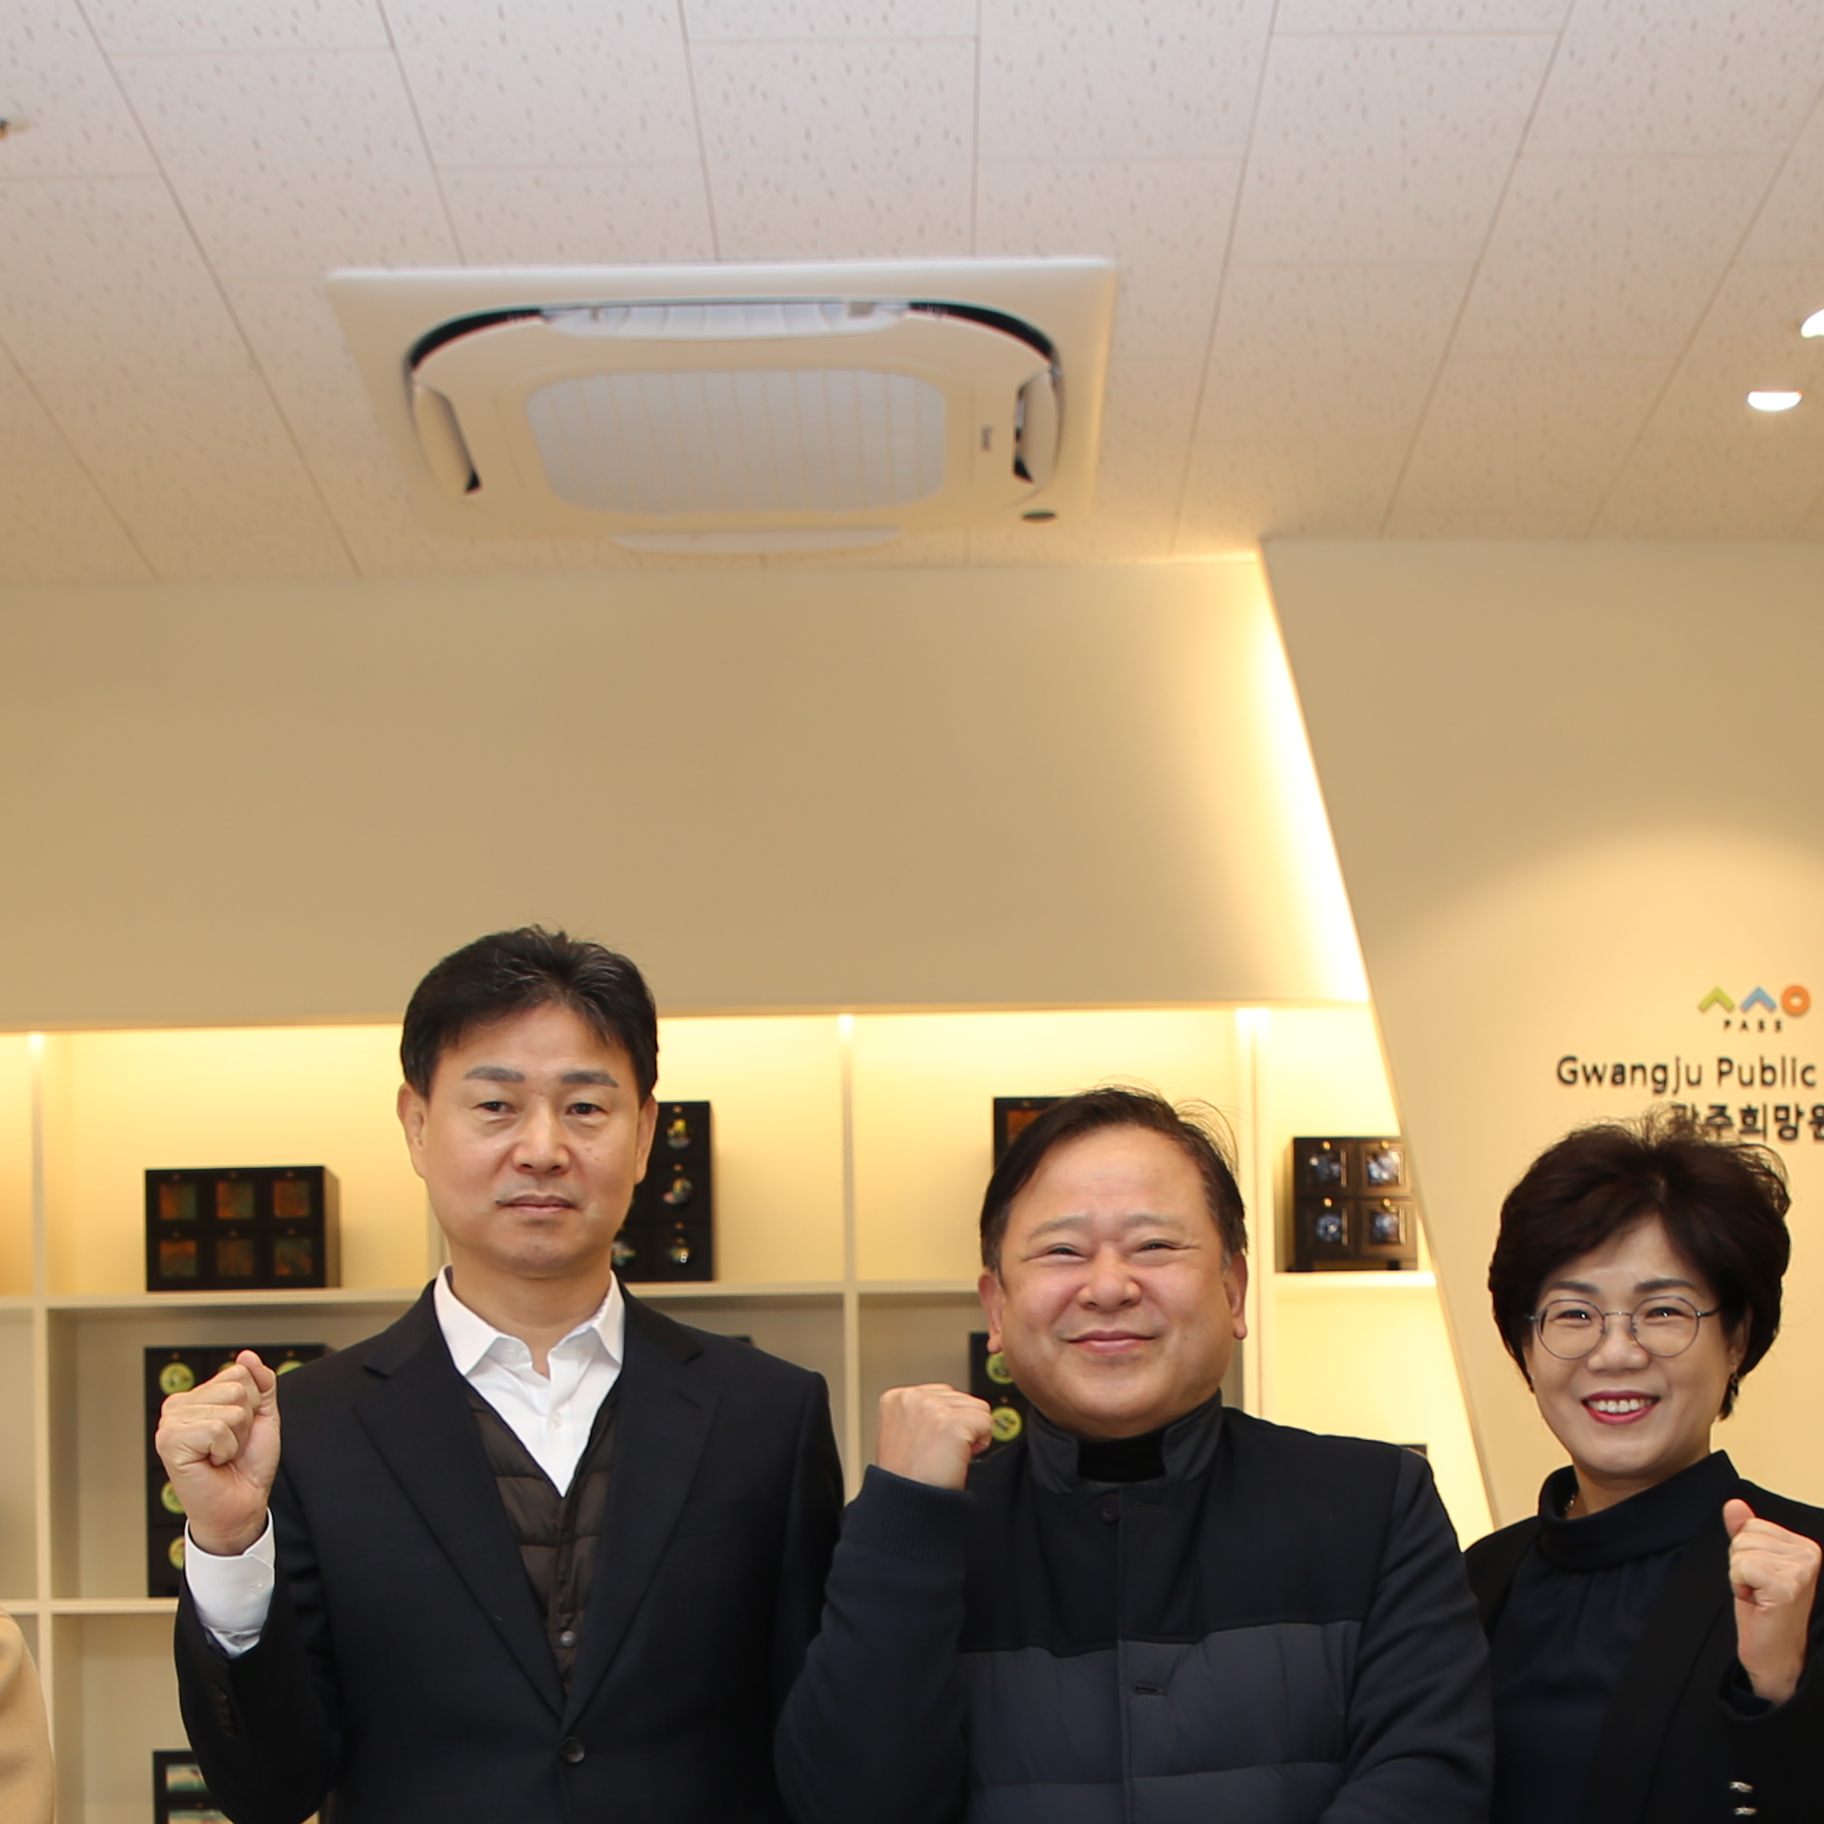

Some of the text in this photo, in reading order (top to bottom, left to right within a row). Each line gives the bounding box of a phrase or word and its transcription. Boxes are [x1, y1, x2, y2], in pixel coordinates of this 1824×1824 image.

[1723, 1018, 1783, 1033] PASS
[1556, 1055, 1703, 1096] Gwangju
[1717, 1055, 1816, 1089] Public
